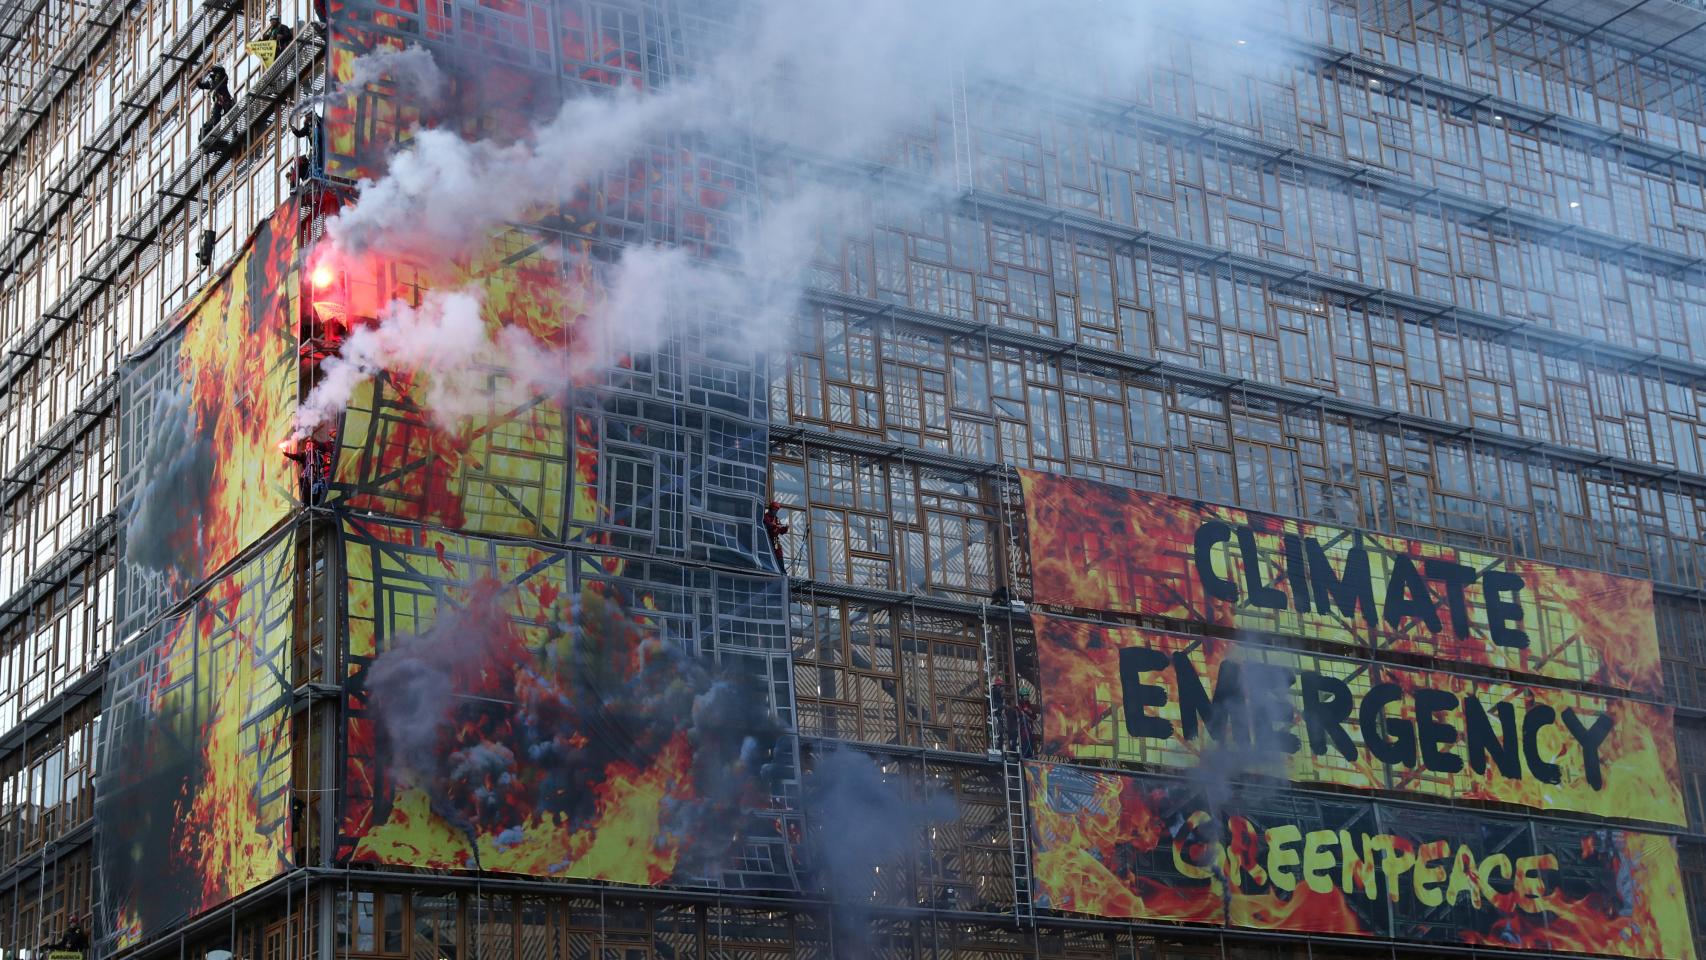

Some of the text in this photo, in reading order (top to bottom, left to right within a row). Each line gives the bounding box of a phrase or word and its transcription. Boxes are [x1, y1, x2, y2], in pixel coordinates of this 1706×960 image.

[1194, 520, 1530, 648] CLIMATE
[1119, 647, 1614, 791] EMERGENCY
[1172, 811, 1560, 914] GREENPEACE
